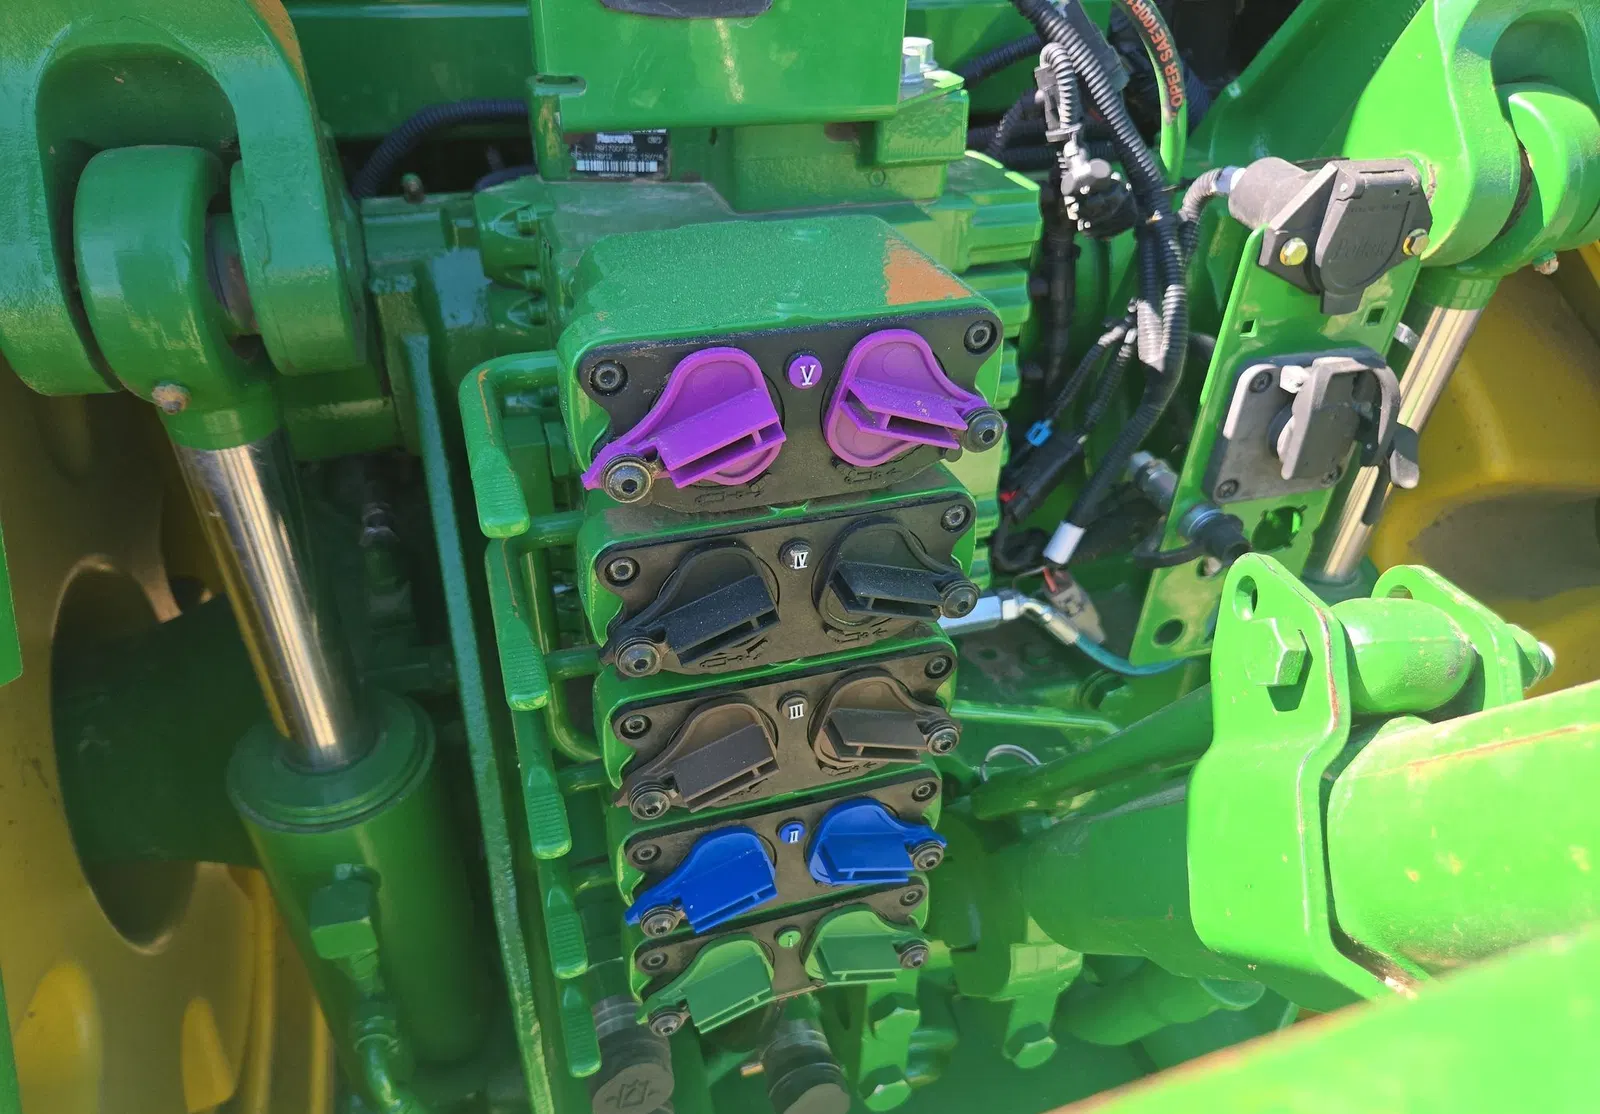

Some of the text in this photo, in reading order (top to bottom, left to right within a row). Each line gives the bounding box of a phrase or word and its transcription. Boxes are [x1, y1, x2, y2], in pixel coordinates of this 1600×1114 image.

[799, 364, 817, 386] V
[790, 550, 809, 570] IV
[788, 703, 805, 720] III
[789, 830, 800, 844] II
